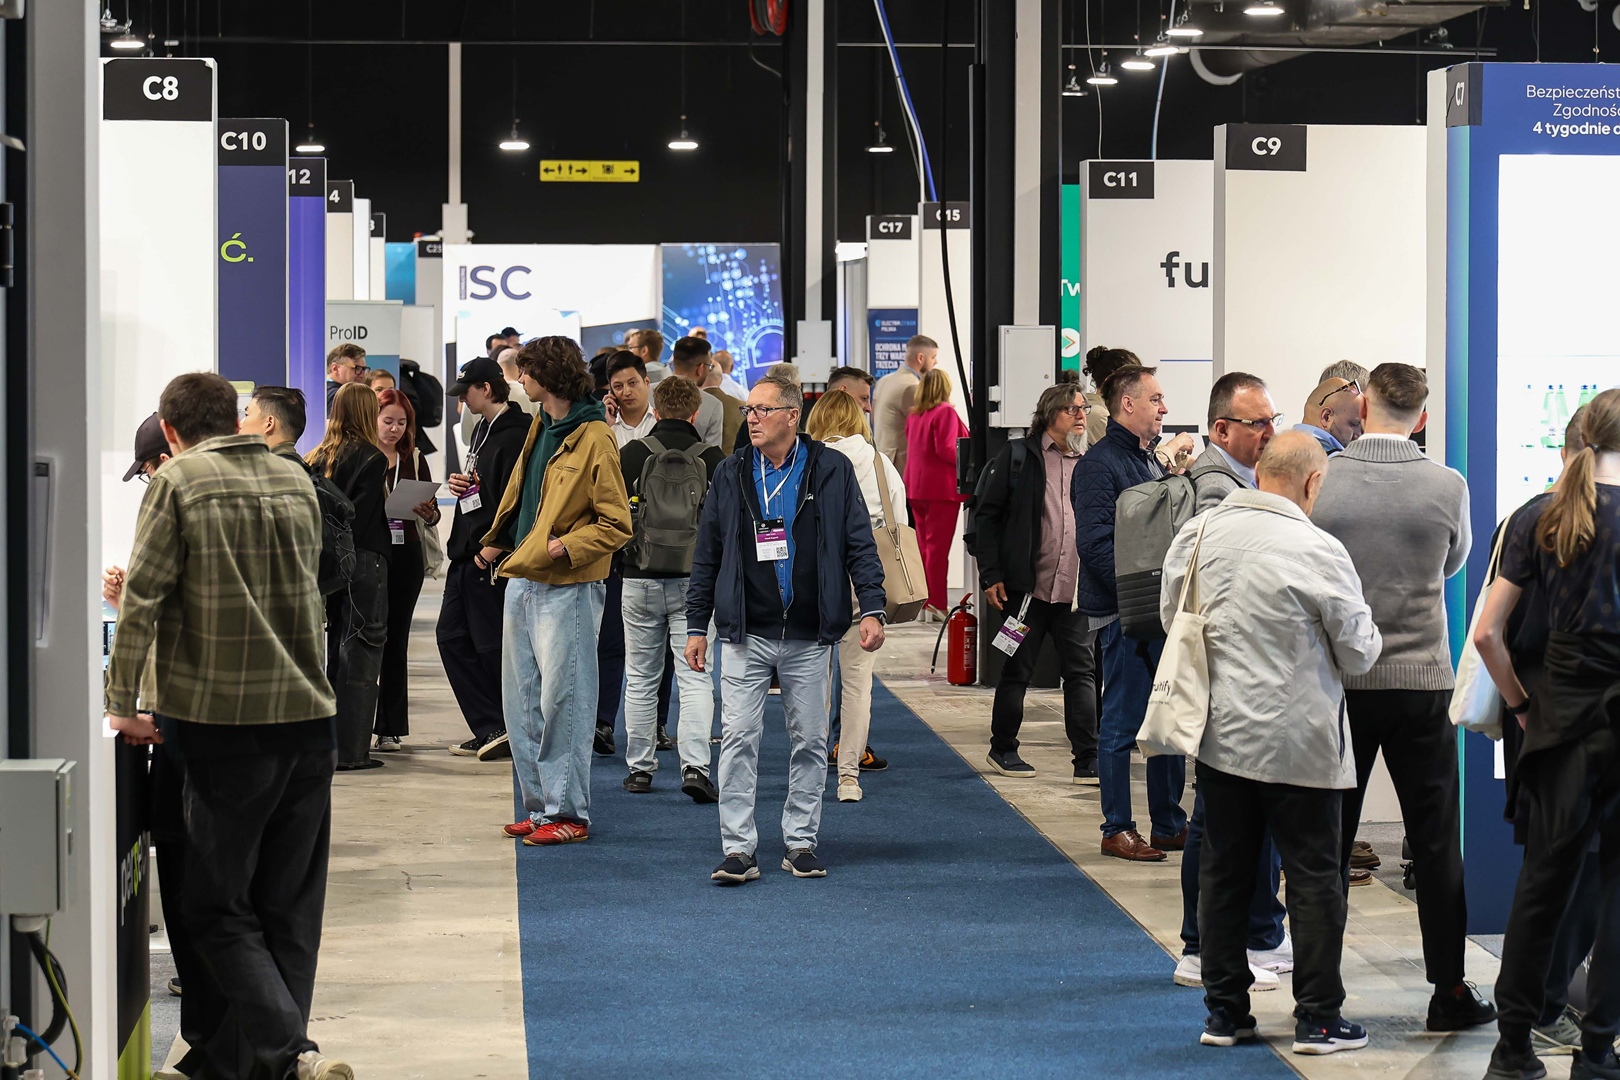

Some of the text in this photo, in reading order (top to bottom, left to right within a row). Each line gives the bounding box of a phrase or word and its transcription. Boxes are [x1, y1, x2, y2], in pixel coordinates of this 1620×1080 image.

[142, 75, 180, 101] C8
[1455, 81, 1465, 107] C7
[1526, 84, 1620, 101] Bezpieczeńst
[1532, 121, 1543, 135] 4
[1545, 121, 1611, 138] tygodnie
[220, 131, 268, 151] C10
[1251, 136, 1283, 157] C9
[1103, 171, 1139, 188] C11
[878, 221, 904, 234] C17
[220, 232, 254, 263] Ć.
[1159, 250, 1210, 289] fu
[329, 325, 368, 340] ProID
